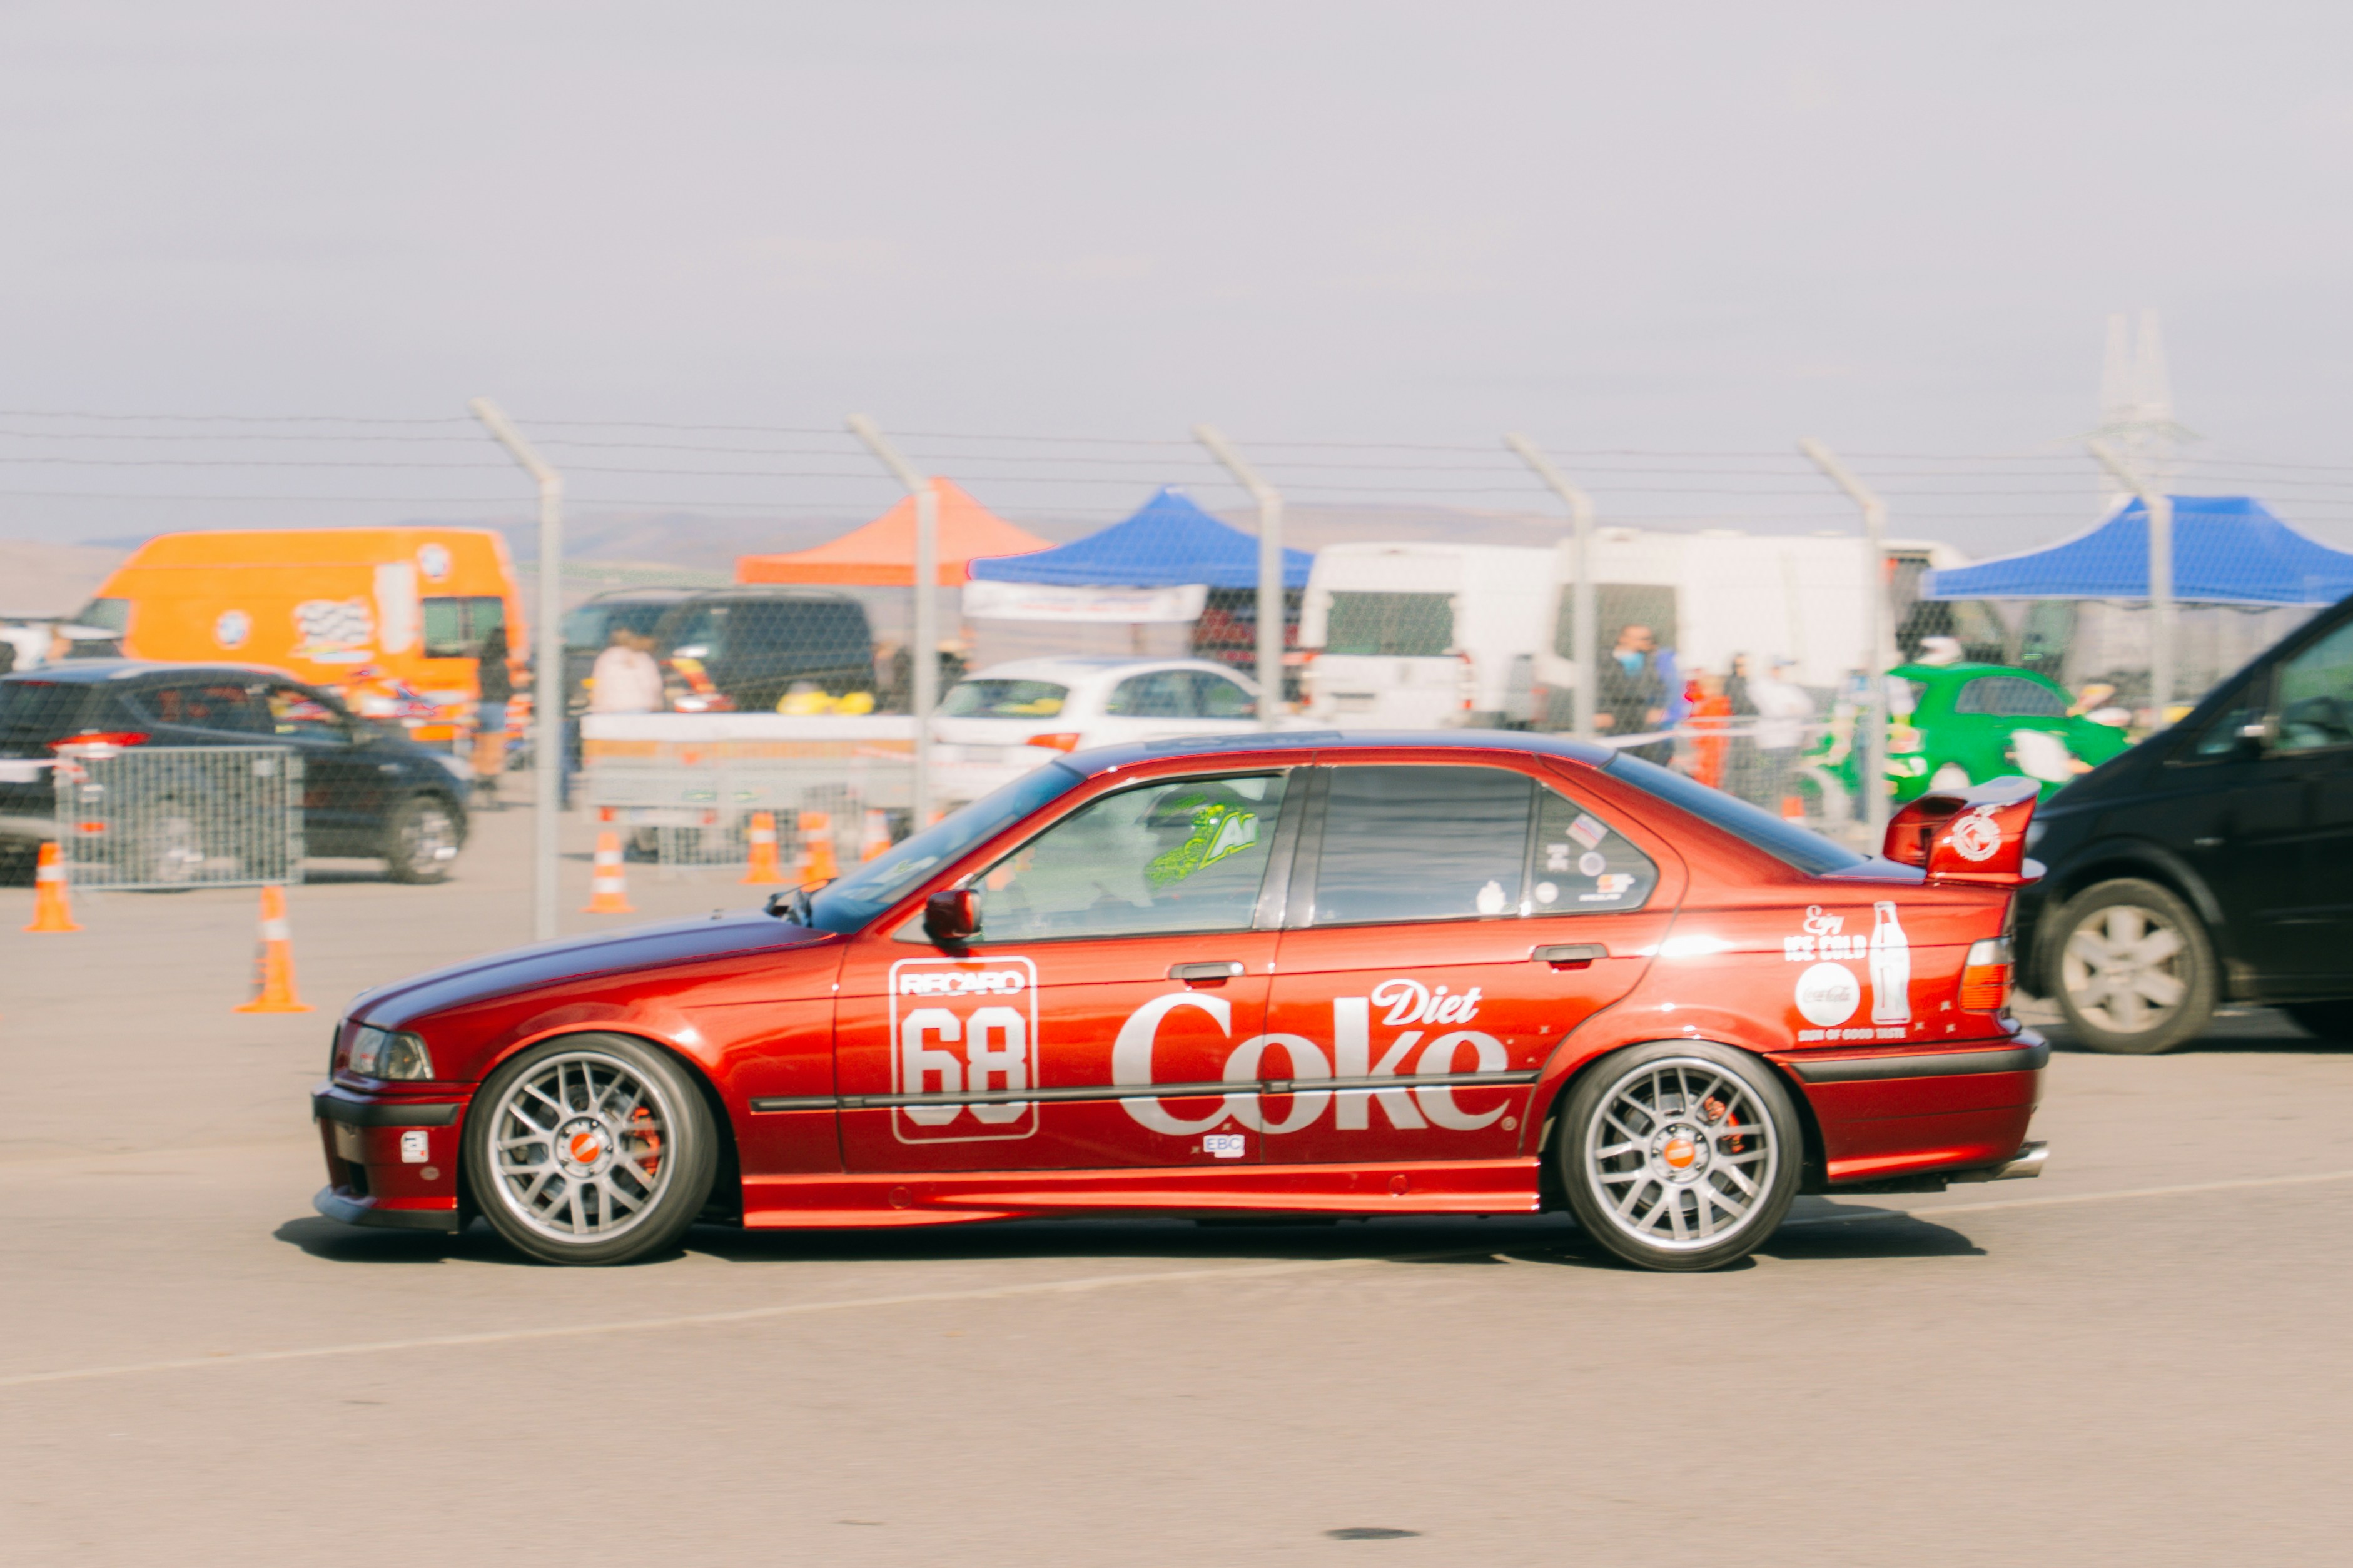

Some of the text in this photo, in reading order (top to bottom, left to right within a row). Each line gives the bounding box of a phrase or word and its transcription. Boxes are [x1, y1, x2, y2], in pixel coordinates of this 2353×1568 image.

[1819, 934, 1867, 961] COLD
[900, 970, 1026, 996] RECARO
[1371, 978, 1482, 1026] Diet
[902, 1006, 1027, 1126] 68
[1112, 992, 1510, 1136] Coke
[1207, 1137, 1242, 1150] EBC
